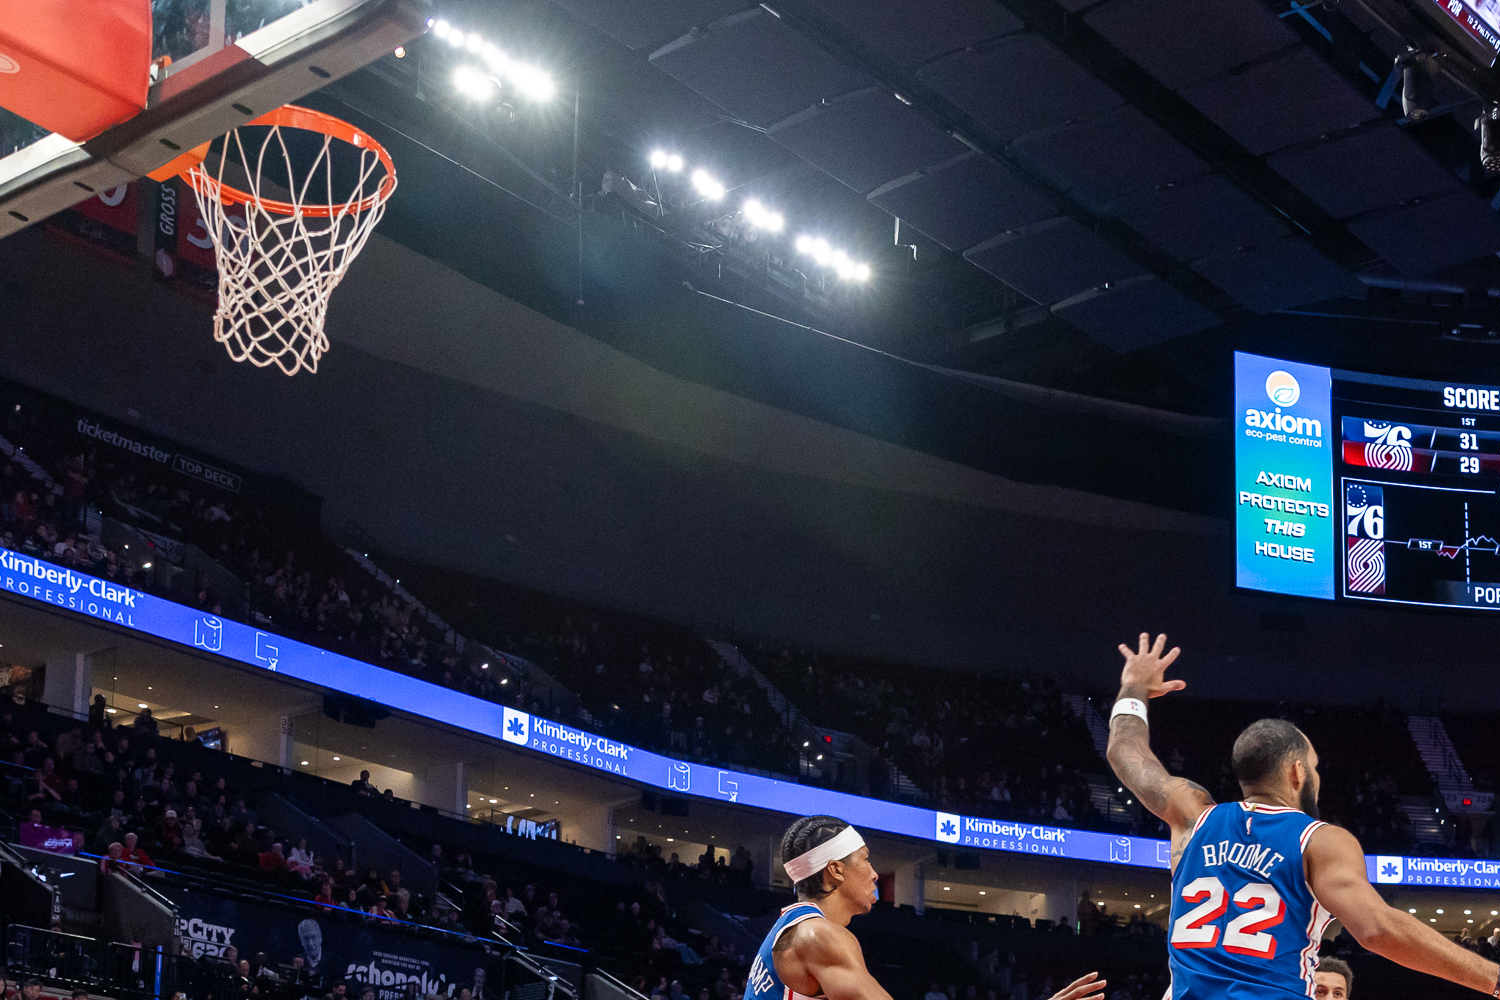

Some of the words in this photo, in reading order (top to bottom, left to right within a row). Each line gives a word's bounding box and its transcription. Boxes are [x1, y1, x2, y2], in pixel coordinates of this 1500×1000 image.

[1447, 0, 1463, 17] POR
[159, 184, 176, 236] GROSS
[1245, 407, 1321, 437] axiom
[1462, 418, 1475, 426] 1ST
[1245, 429, 1286, 442] eco-pest
[1289, 436, 1322, 448] control
[1460, 433, 1478, 450] 31
[77, 418, 171, 465] ticketmaster
[179, 458, 202, 476] TOP
[204, 466, 235, 488] DECK
[1460, 457, 1479, 473] 29
[1256, 471, 1311, 491] AXIOM
[1240, 491, 1329, 516] PROTECTS
[1265, 519, 1306, 536] THIS
[1348, 503, 1384, 539] 76
[1256, 541, 1315, 562] HOUSE
[1419, 541, 1432, 549] 1ST
[532, 739, 628, 776] PROFESSIONAL
[965, 836, 1066, 856] PROFESSIONAL
[1202, 840, 1285, 878] BROOME
[1170, 876, 1287, 960] 22
